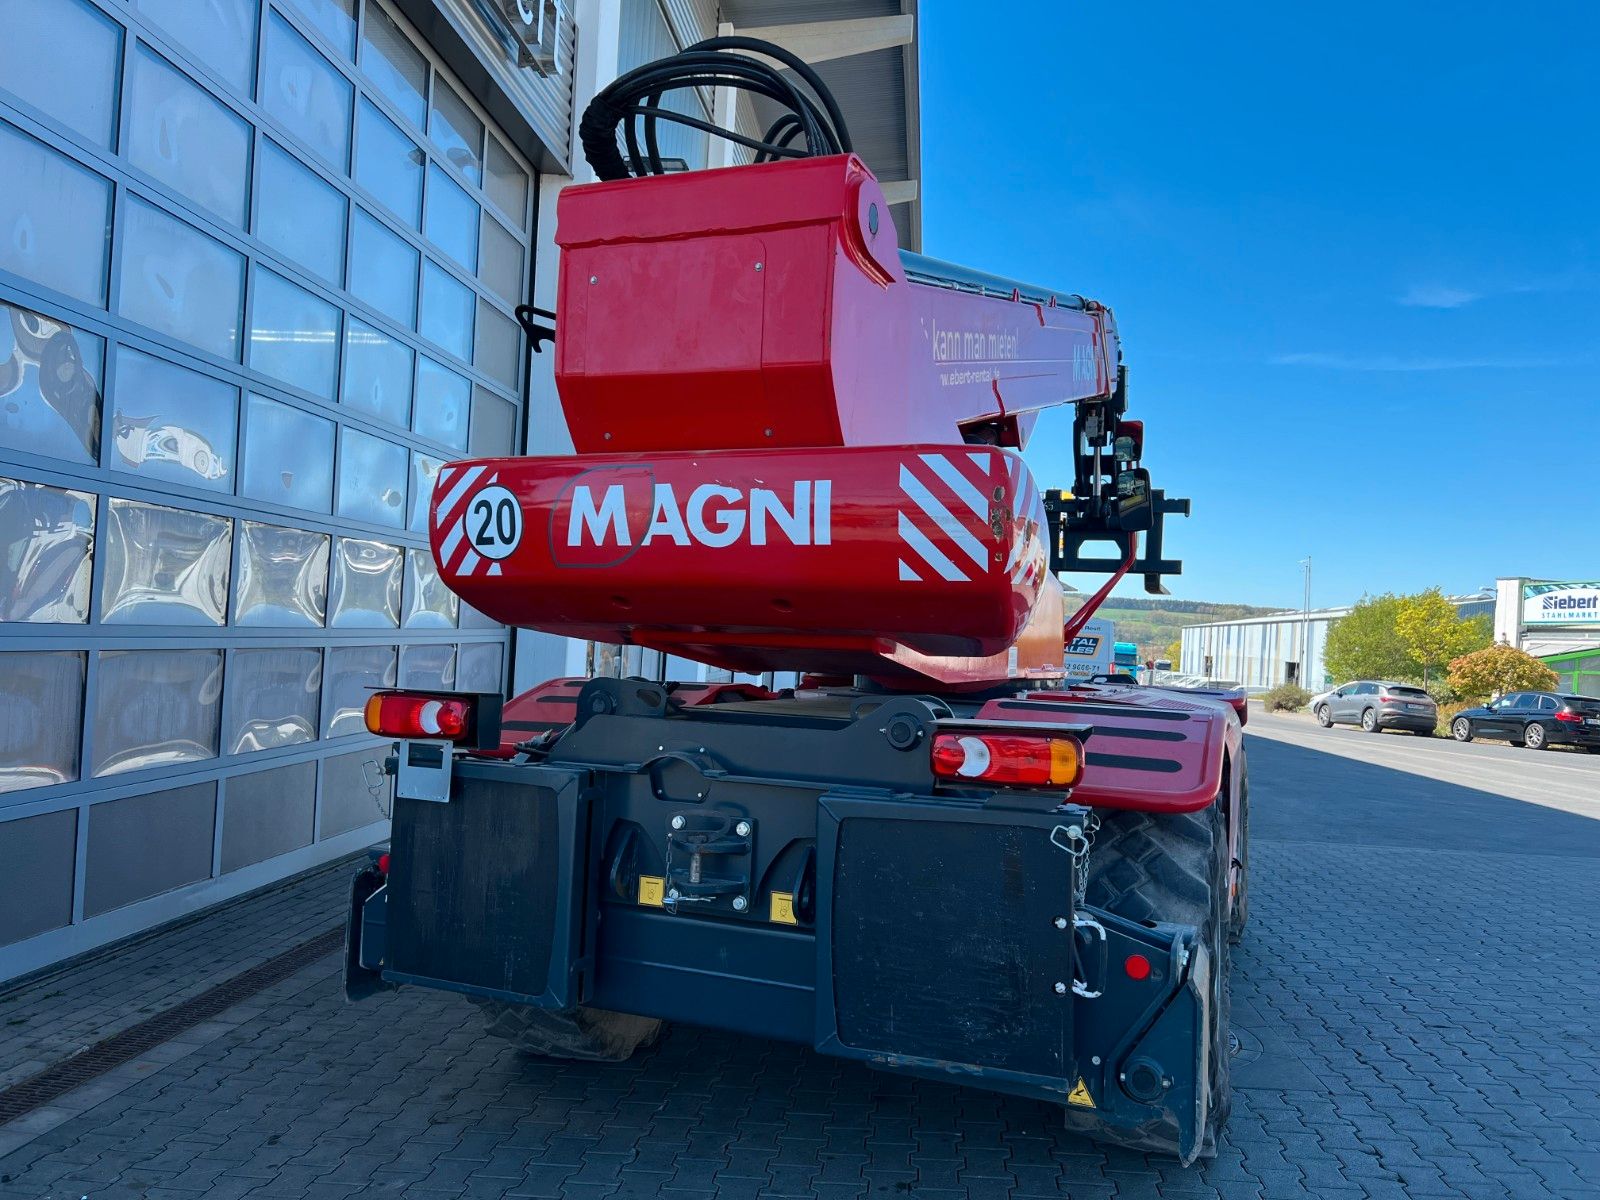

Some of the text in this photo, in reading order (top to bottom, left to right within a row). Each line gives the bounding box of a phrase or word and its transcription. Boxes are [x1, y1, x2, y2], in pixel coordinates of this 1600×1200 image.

[932, 318, 961, 361] kann
[963, 331, 986, 361] man
[473, 498, 516, 546] 20
[567, 479, 832, 548] MAGNI
[1541, 611, 1599, 619] STAHLMARKT
